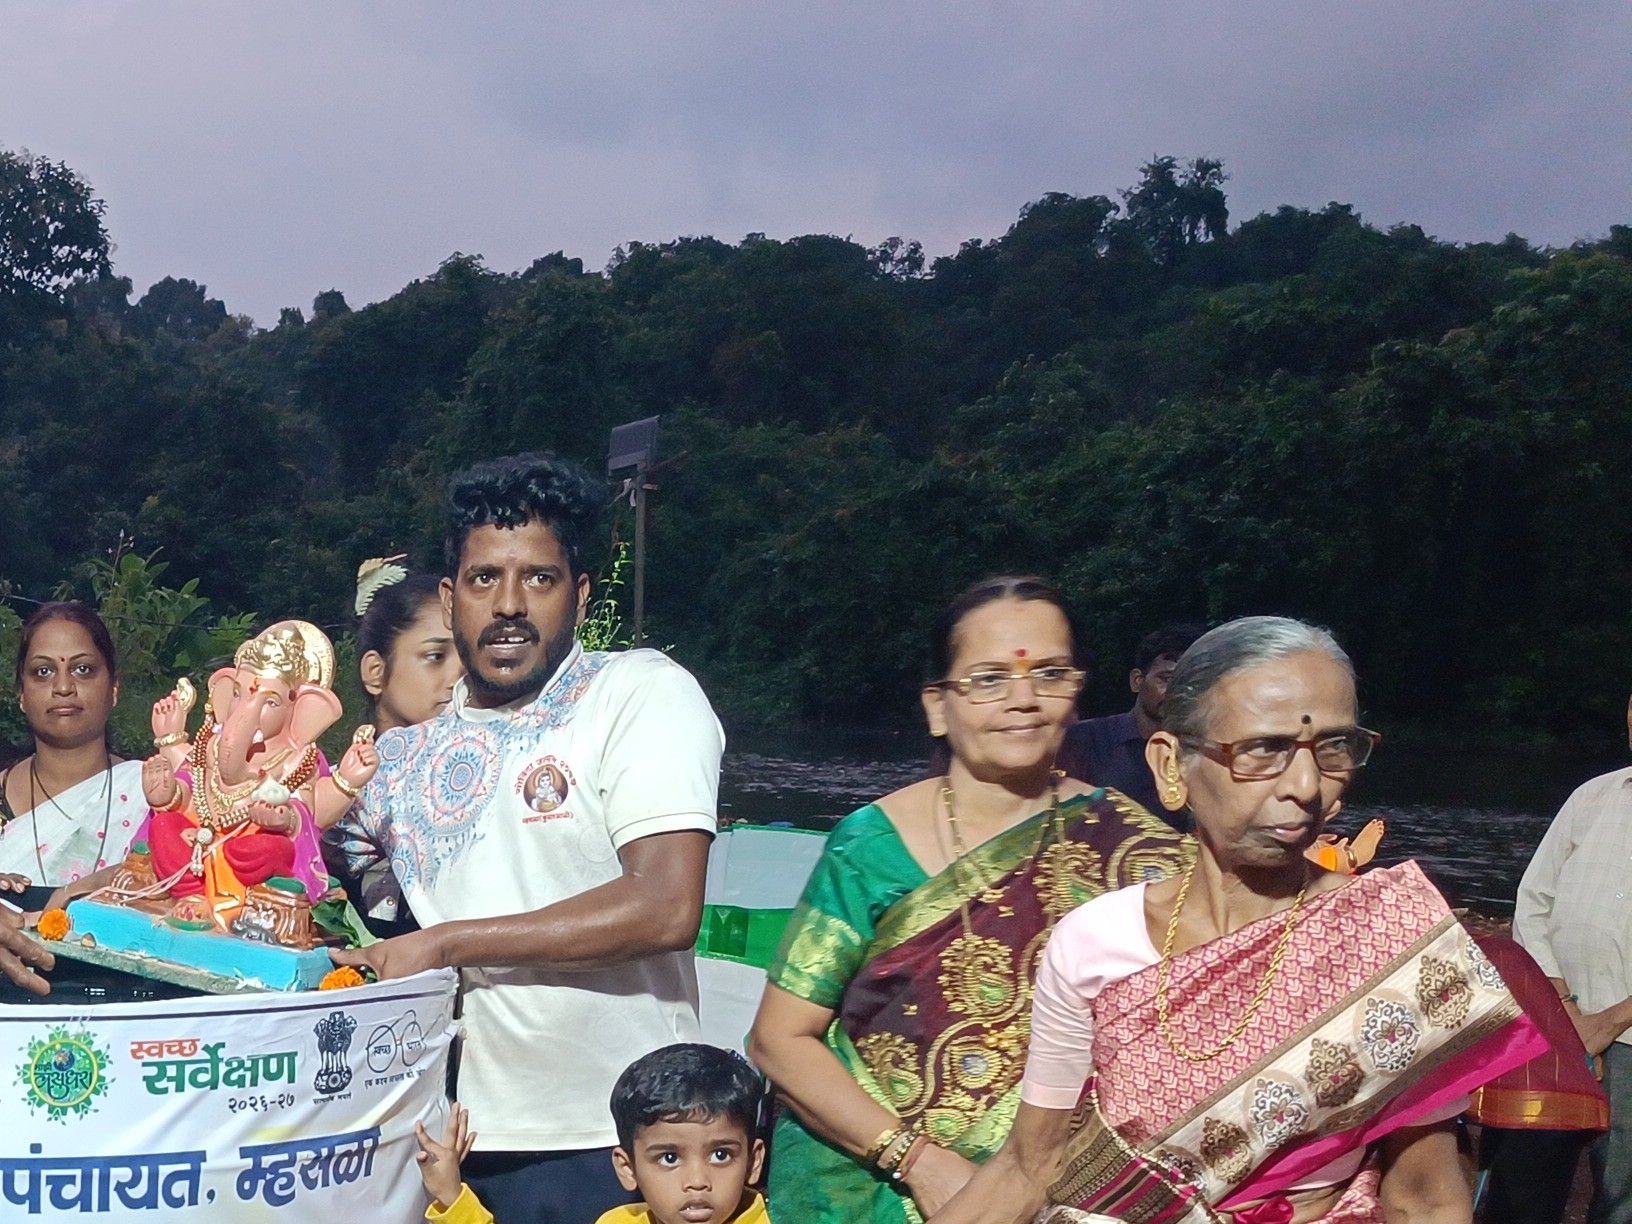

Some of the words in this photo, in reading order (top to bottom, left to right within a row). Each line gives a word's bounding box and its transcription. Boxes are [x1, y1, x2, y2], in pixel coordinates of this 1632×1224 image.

[131, 1038, 200, 1061] स्वच्छ
[142, 1042, 299, 1096] सर्वेक्षण
[228, 1092, 295, 1114] २०२६-२७
[236, 1125, 382, 1207] म्हसळा
